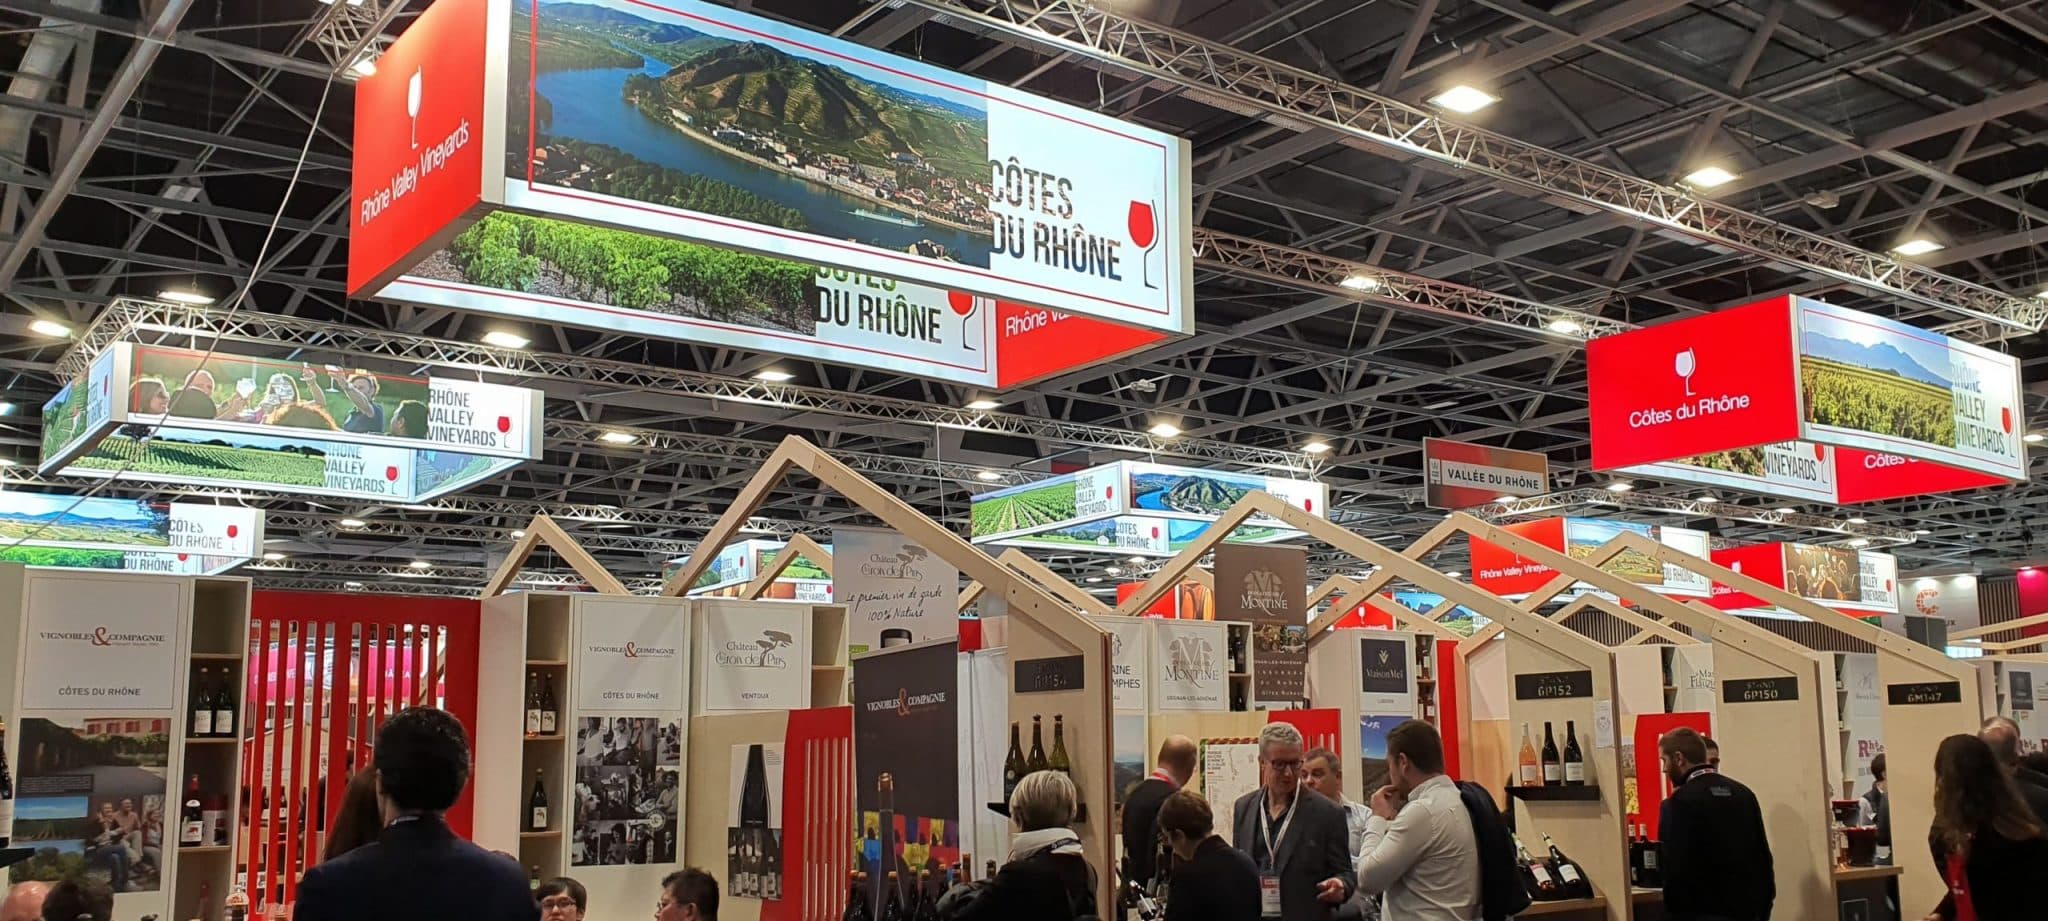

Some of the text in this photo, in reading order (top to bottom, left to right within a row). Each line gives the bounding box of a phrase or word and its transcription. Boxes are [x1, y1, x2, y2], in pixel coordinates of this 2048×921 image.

[361, 118, 469, 226] Rhône Valley Vineyards
[989, 155, 1073, 220] CÔTES
[991, 212, 1122, 282] DU RHÔNE
[817, 286, 942, 344] DU RHÔNE
[1005, 310, 1047, 337] Rhône
[428, 388, 471, 408] RHÔNE
[1953, 392, 1985, 422] VALLEY
[427, 408, 474, 427] VALLEY
[1629, 395, 1749, 428] Côtes du Rhône
[427, 426, 496, 447] VINEYARDS
[1955, 421, 2005, 455] VINEYARDS
[324, 460, 366, 475] VALLEY
[1765, 452, 1816, 481] VINEYARDS
[1865, 453, 1905, 469] Côtes
[324, 475, 385, 493] VINEYARDS
[1447, 468, 1485, 483] VALLÉE
[1488, 474, 1502, 485] DU
[1505, 475, 1540, 490] RHÔNE
[170, 517, 203, 533] CÔTES
[169, 535, 183, 547] DU
[124, 557, 174, 572] DU RHÔNE
[855, 590, 890, 613] premier
[907, 586, 918, 599] de
[919, 585, 942, 607] garde
[1241, 593, 1288, 613] MONTINE
[40, 632, 95, 641] VIGNOBLES
[108, 633, 165, 642] COMPAGNIE
[726, 641, 758, 651] Château
[1112, 665, 1131, 675] AINE
[1165, 662, 1219, 685] MONTINE
[58, 685, 141, 696] CÔTES DU RHÔNE
[1112, 678, 1140, 689] MPHES
[1537, 684, 1572, 697] GP152
[602, 691, 625, 699] CÔTES
[907, 692, 945, 706] COMPAGNIE
[1743, 689, 1778, 701] GP150
